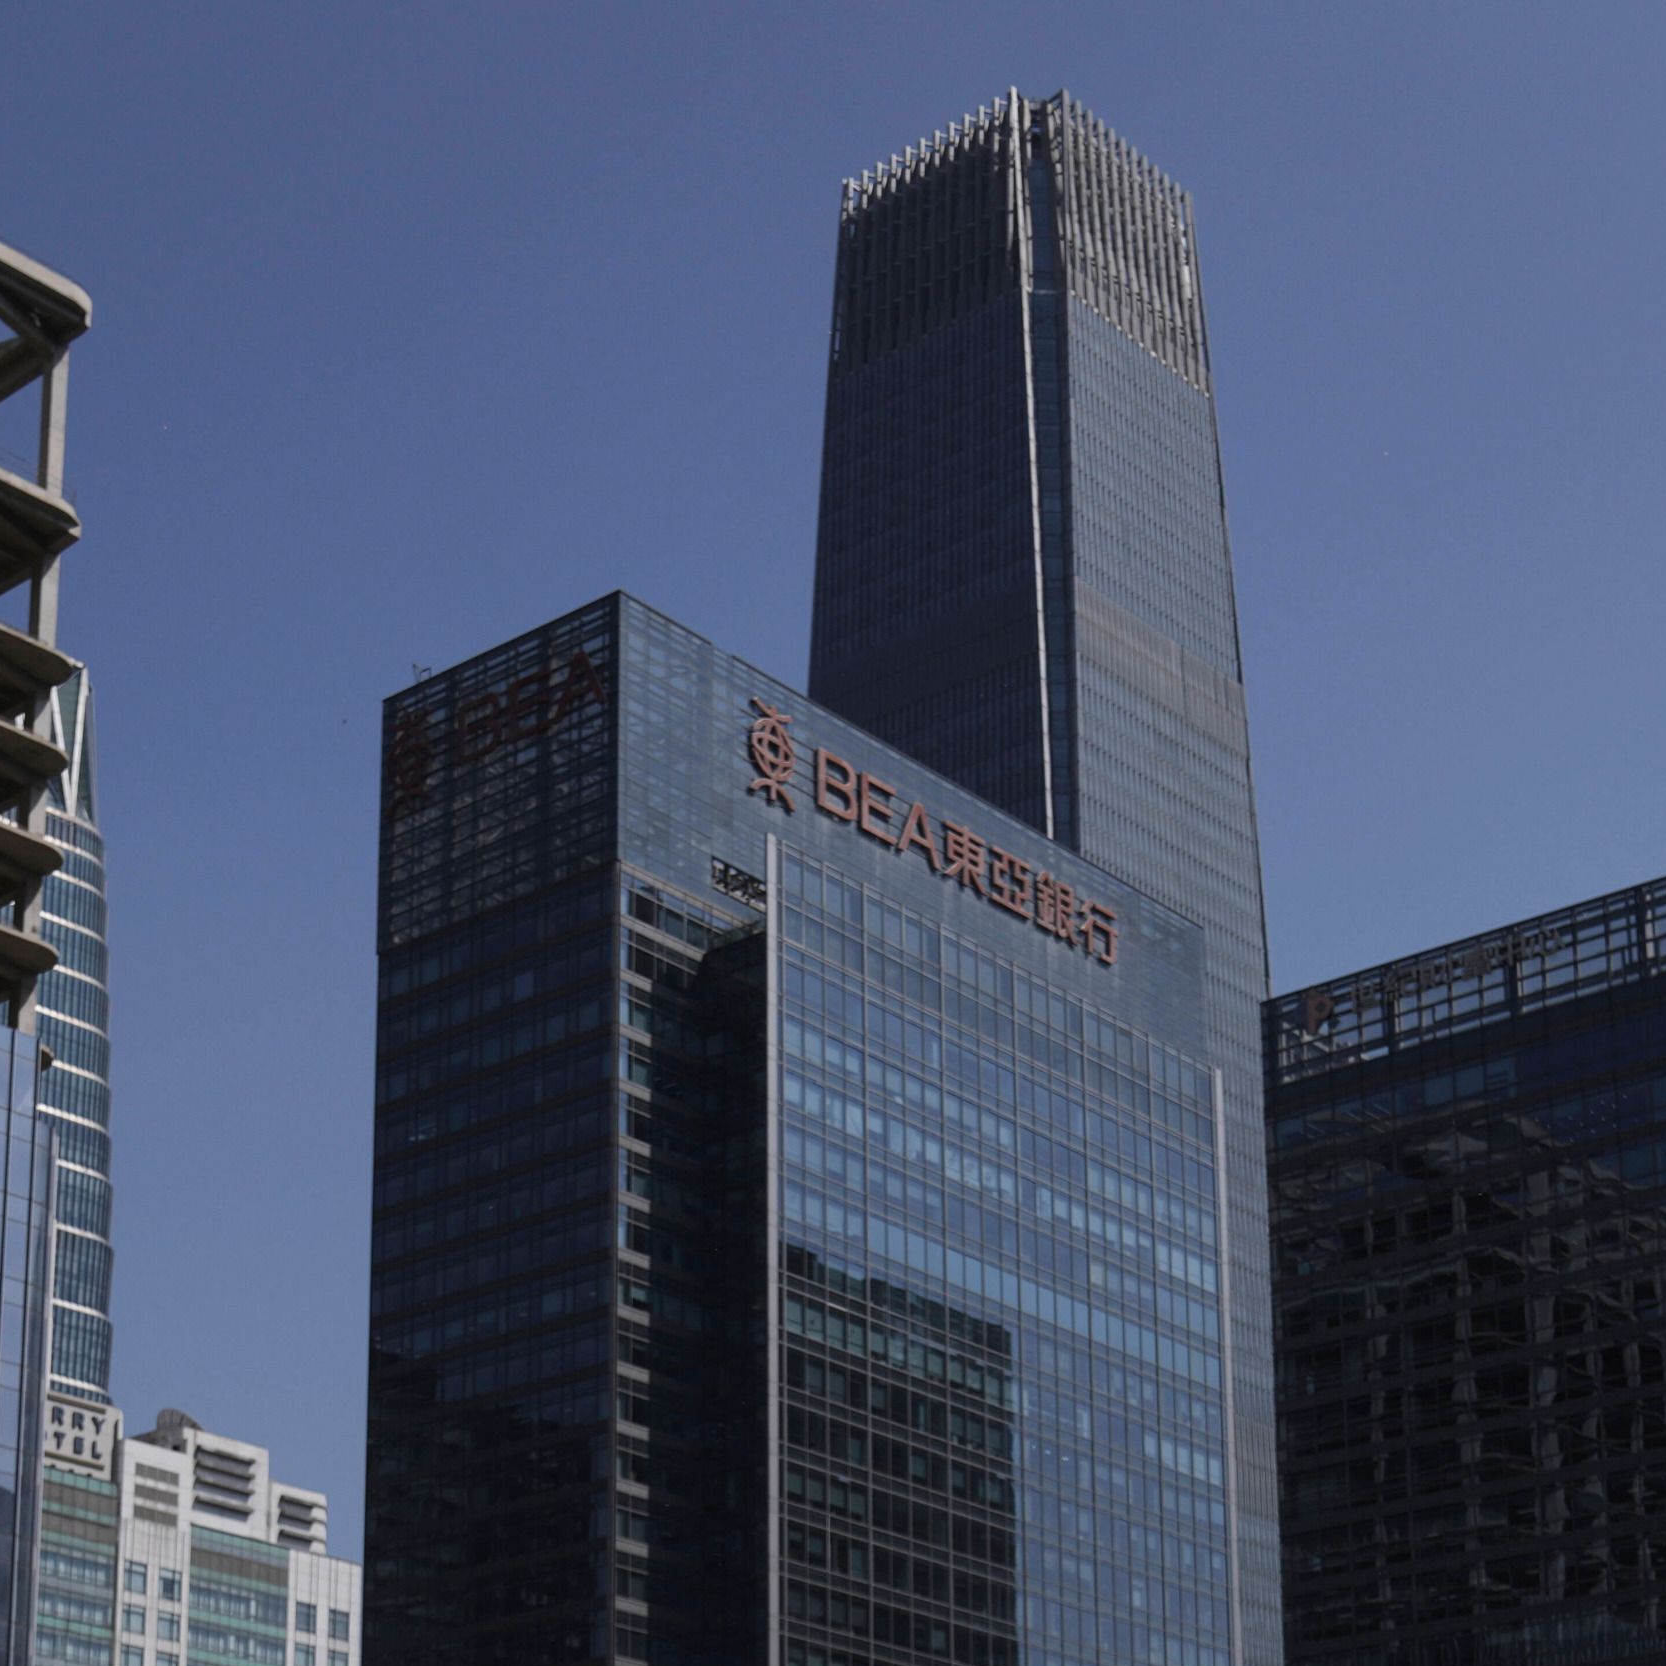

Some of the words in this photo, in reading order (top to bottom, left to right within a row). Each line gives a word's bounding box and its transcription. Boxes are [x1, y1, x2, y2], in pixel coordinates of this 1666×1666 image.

[815, 748, 941, 871] BEA
[943, 819, 1119, 966] 東亞銀行
[51, 1405, 106, 1435] RRY
[52, 1431, 102, 1460] TEL
